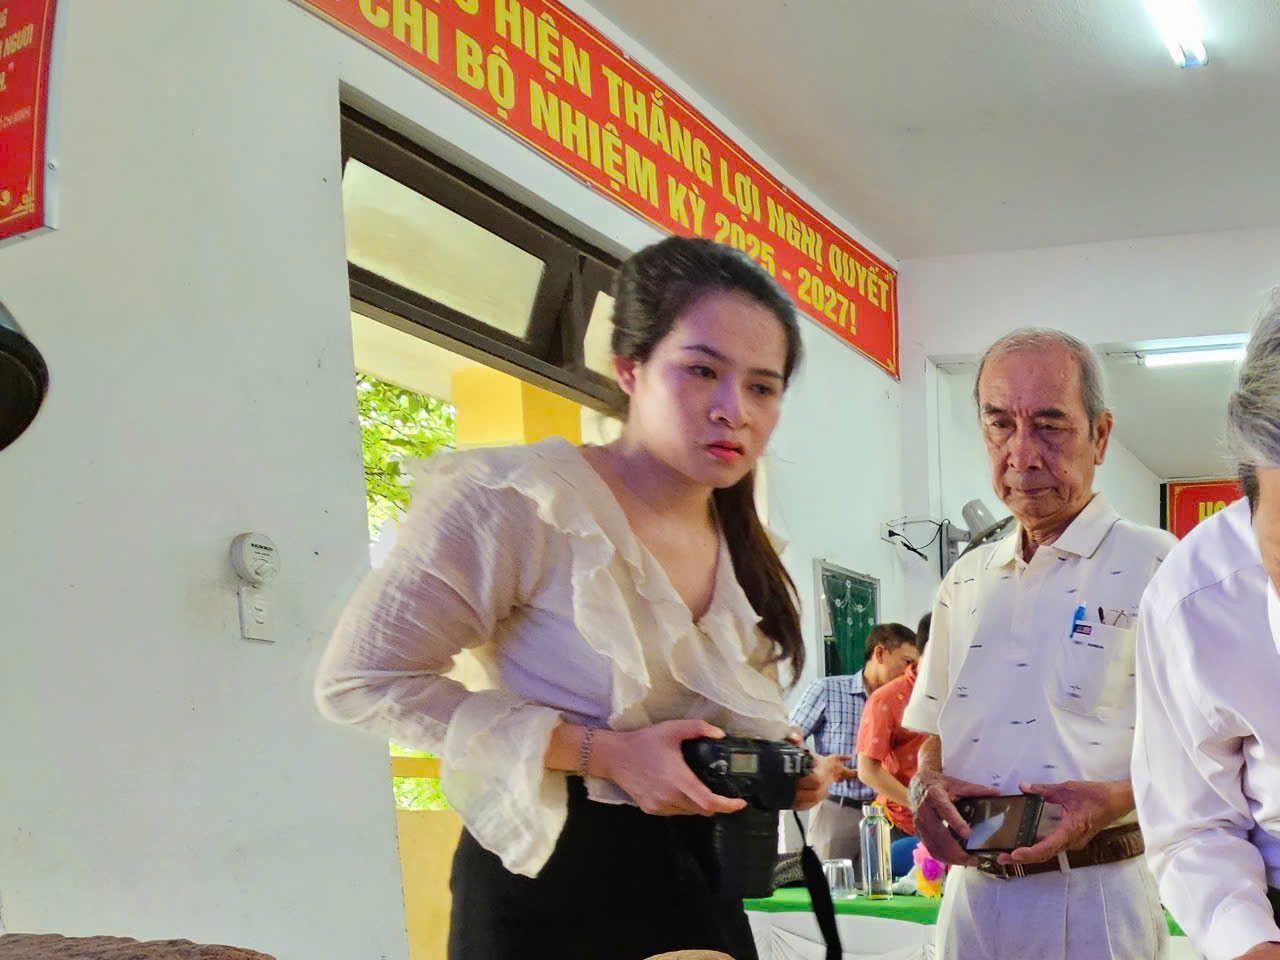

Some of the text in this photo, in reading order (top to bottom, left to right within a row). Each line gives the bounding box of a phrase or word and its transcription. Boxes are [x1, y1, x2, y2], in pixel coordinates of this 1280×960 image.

[456, 28, 515, 120] BỘ
[529, 78, 659, 208] NHIỆM
[667, 174, 706, 237] KỲ
[797, 267, 857, 336] 2027!
[494, 0, 889, 312] HIỆN THẮNG LỢI NGHỊ QUYẾT
